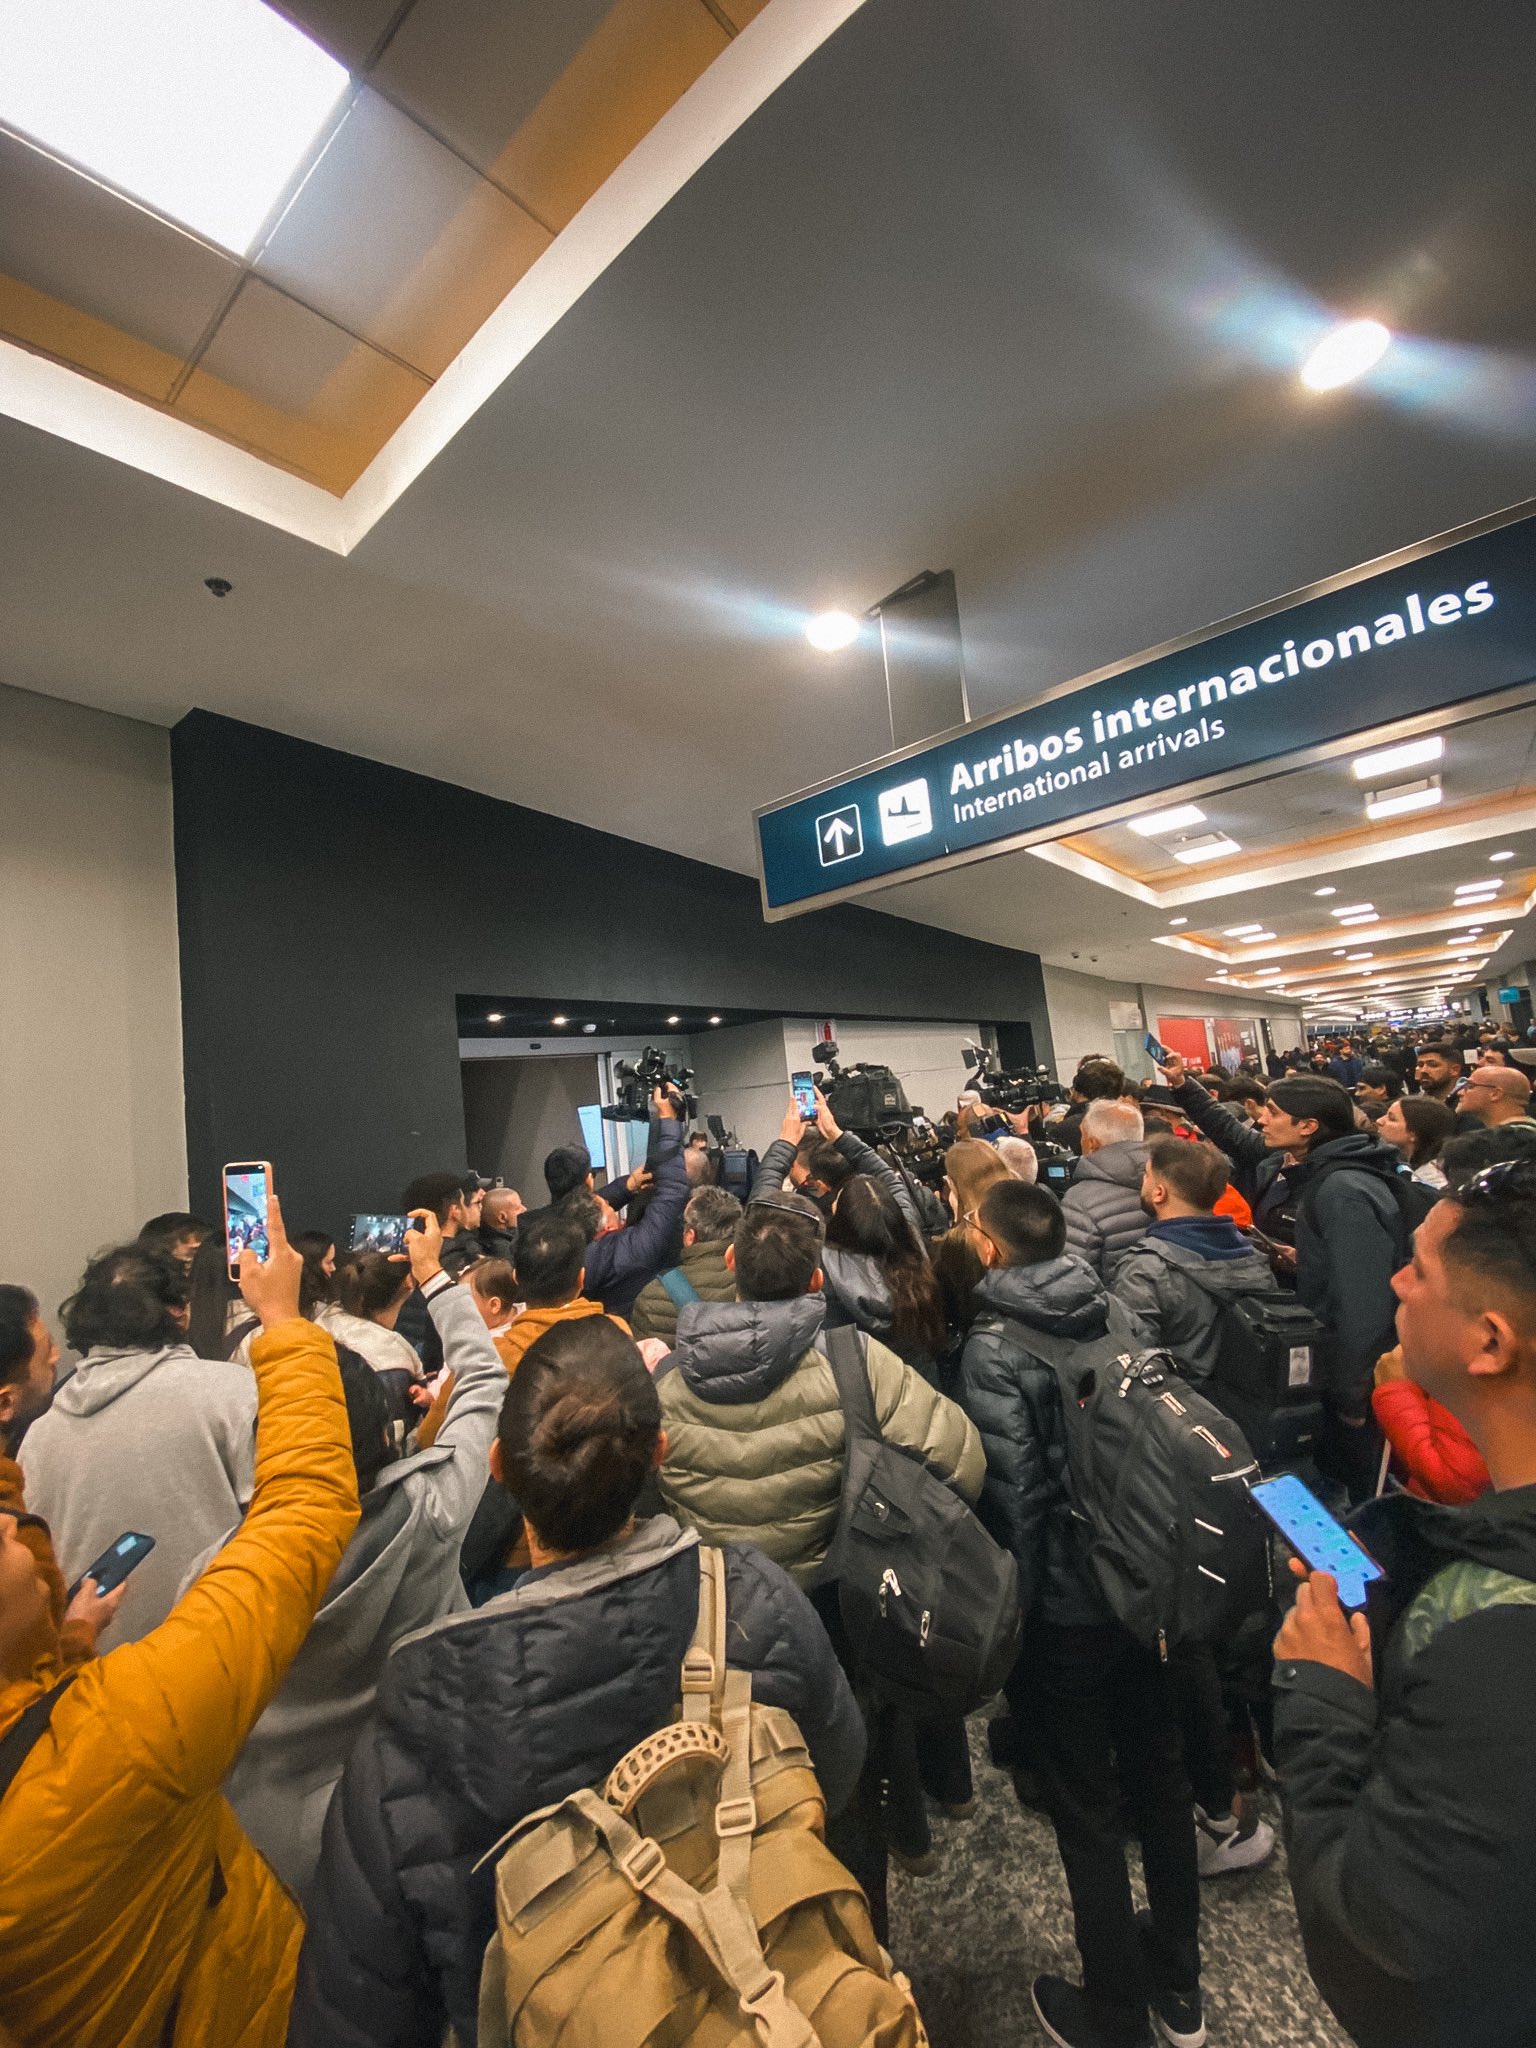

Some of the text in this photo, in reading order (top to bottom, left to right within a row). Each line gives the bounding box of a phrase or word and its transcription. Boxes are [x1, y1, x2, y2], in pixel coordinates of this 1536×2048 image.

[950, 581, 1494, 795] Arribos internacionales
[954, 718, 1226, 823] International arrivals
